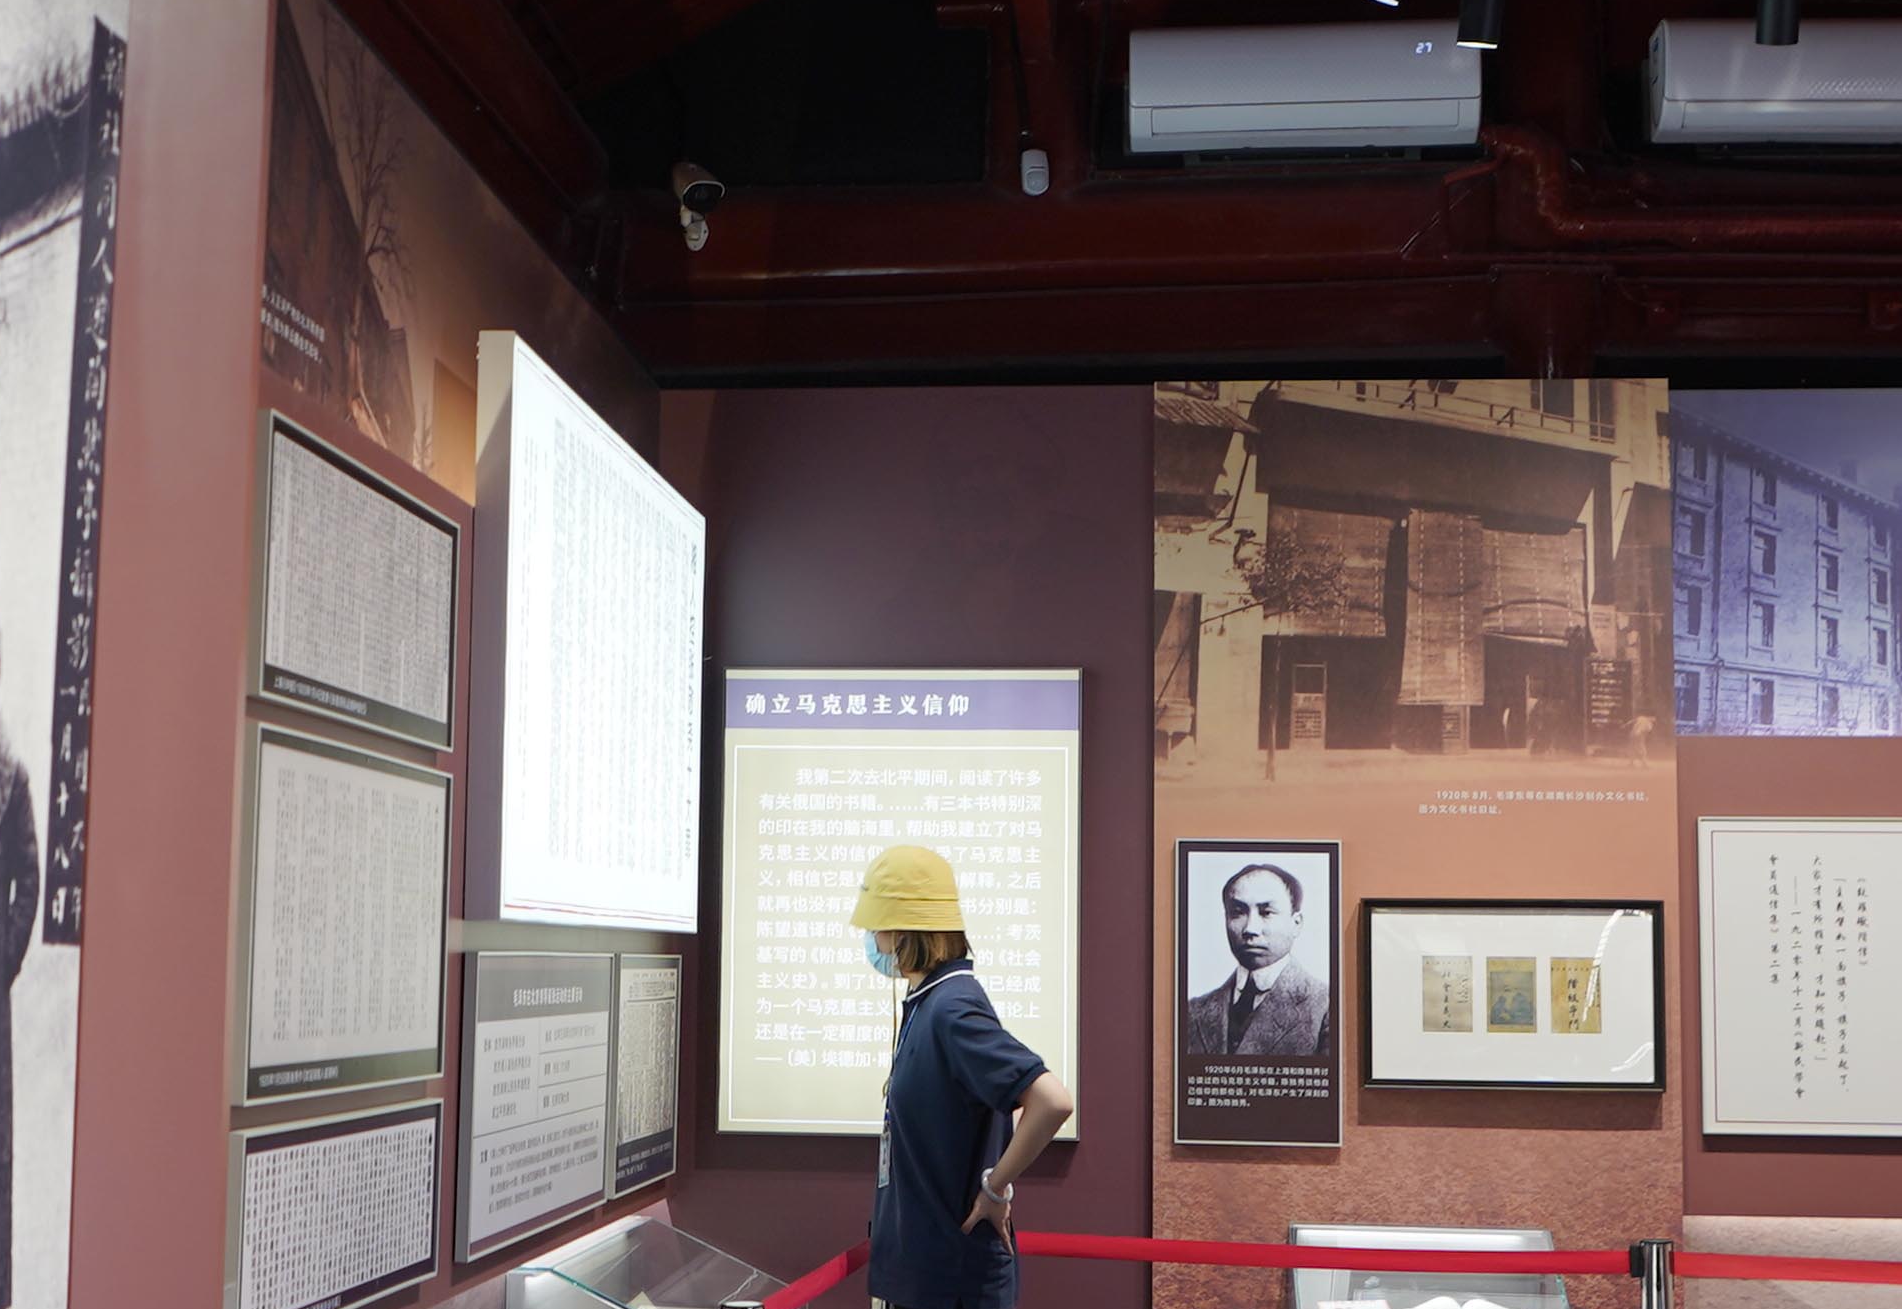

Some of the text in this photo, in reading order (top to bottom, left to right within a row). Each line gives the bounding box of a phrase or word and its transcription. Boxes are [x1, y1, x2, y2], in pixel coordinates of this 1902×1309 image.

[1415, 42, 1433, 54] 27
[745, 693, 970, 716] 确立马克思主义信仰
[757, 998, 902, 1017] 为一个马克思主义
